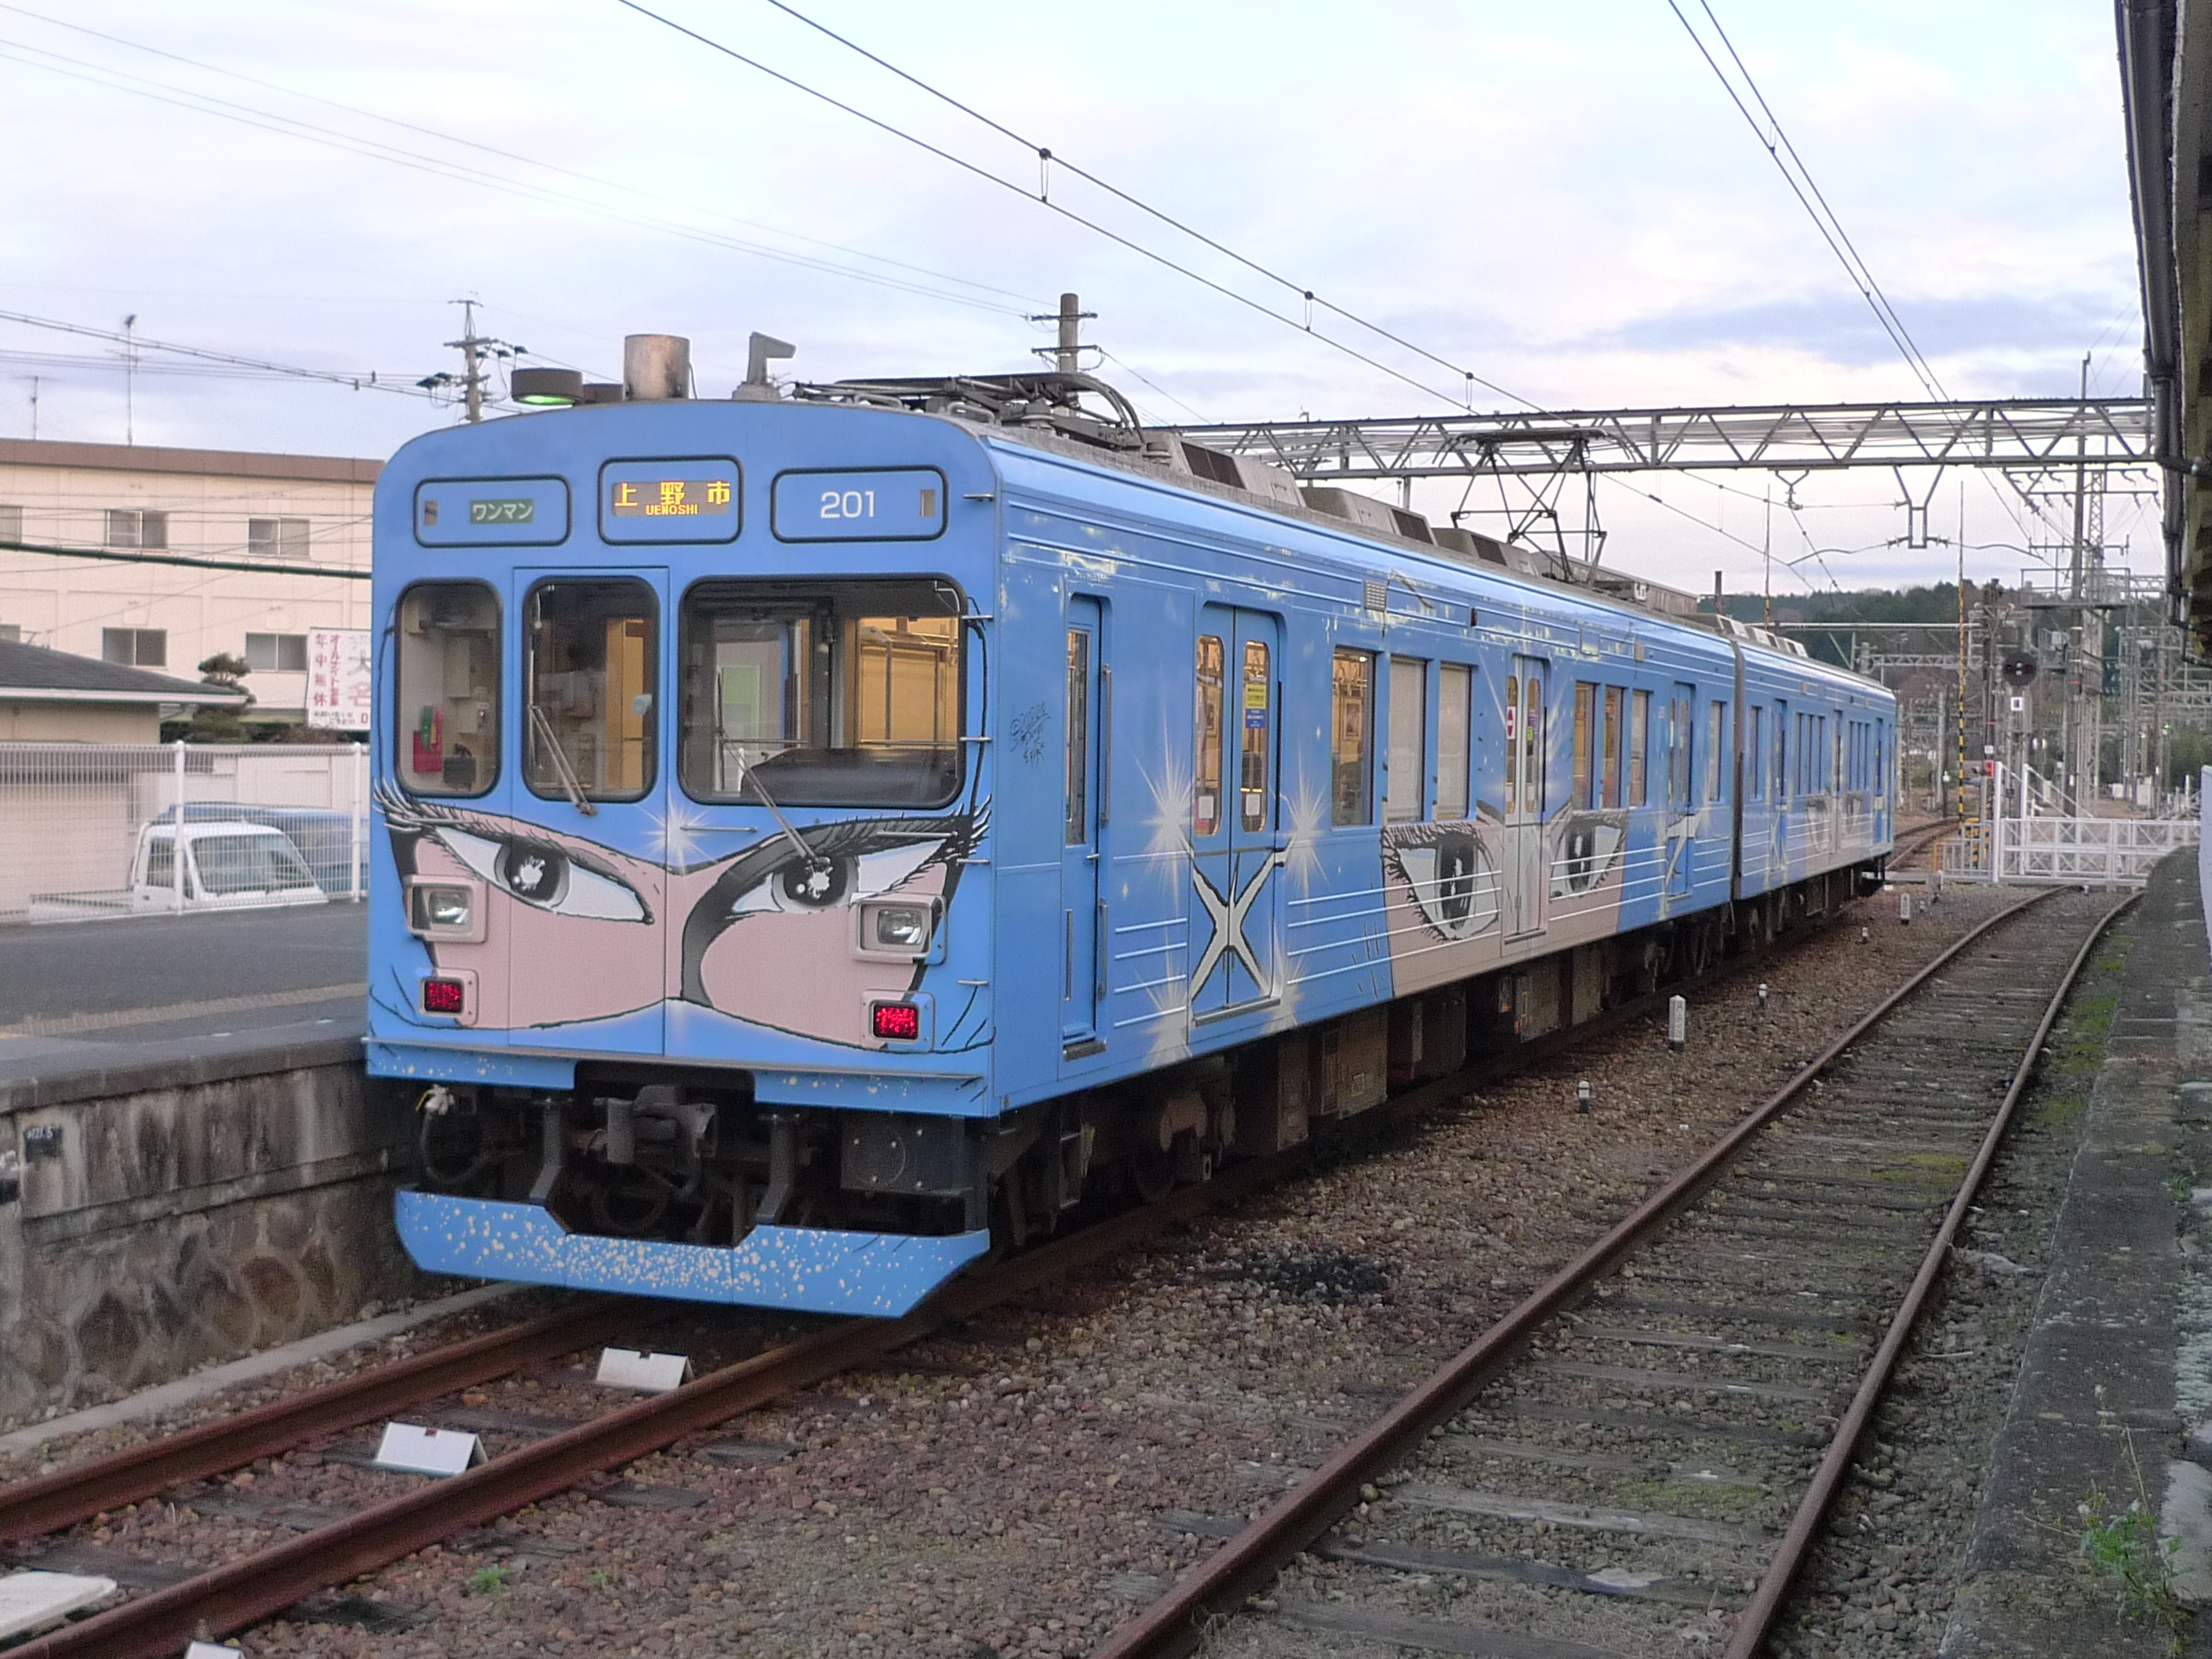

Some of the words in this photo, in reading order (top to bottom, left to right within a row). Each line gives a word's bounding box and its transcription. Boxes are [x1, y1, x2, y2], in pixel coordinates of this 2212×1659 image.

[615, 481, 731, 506] 上野市
[473, 504, 533, 521] ワンマン
[646, 504, 699, 516] UENOSHI
[821, 491, 875, 519] 201
